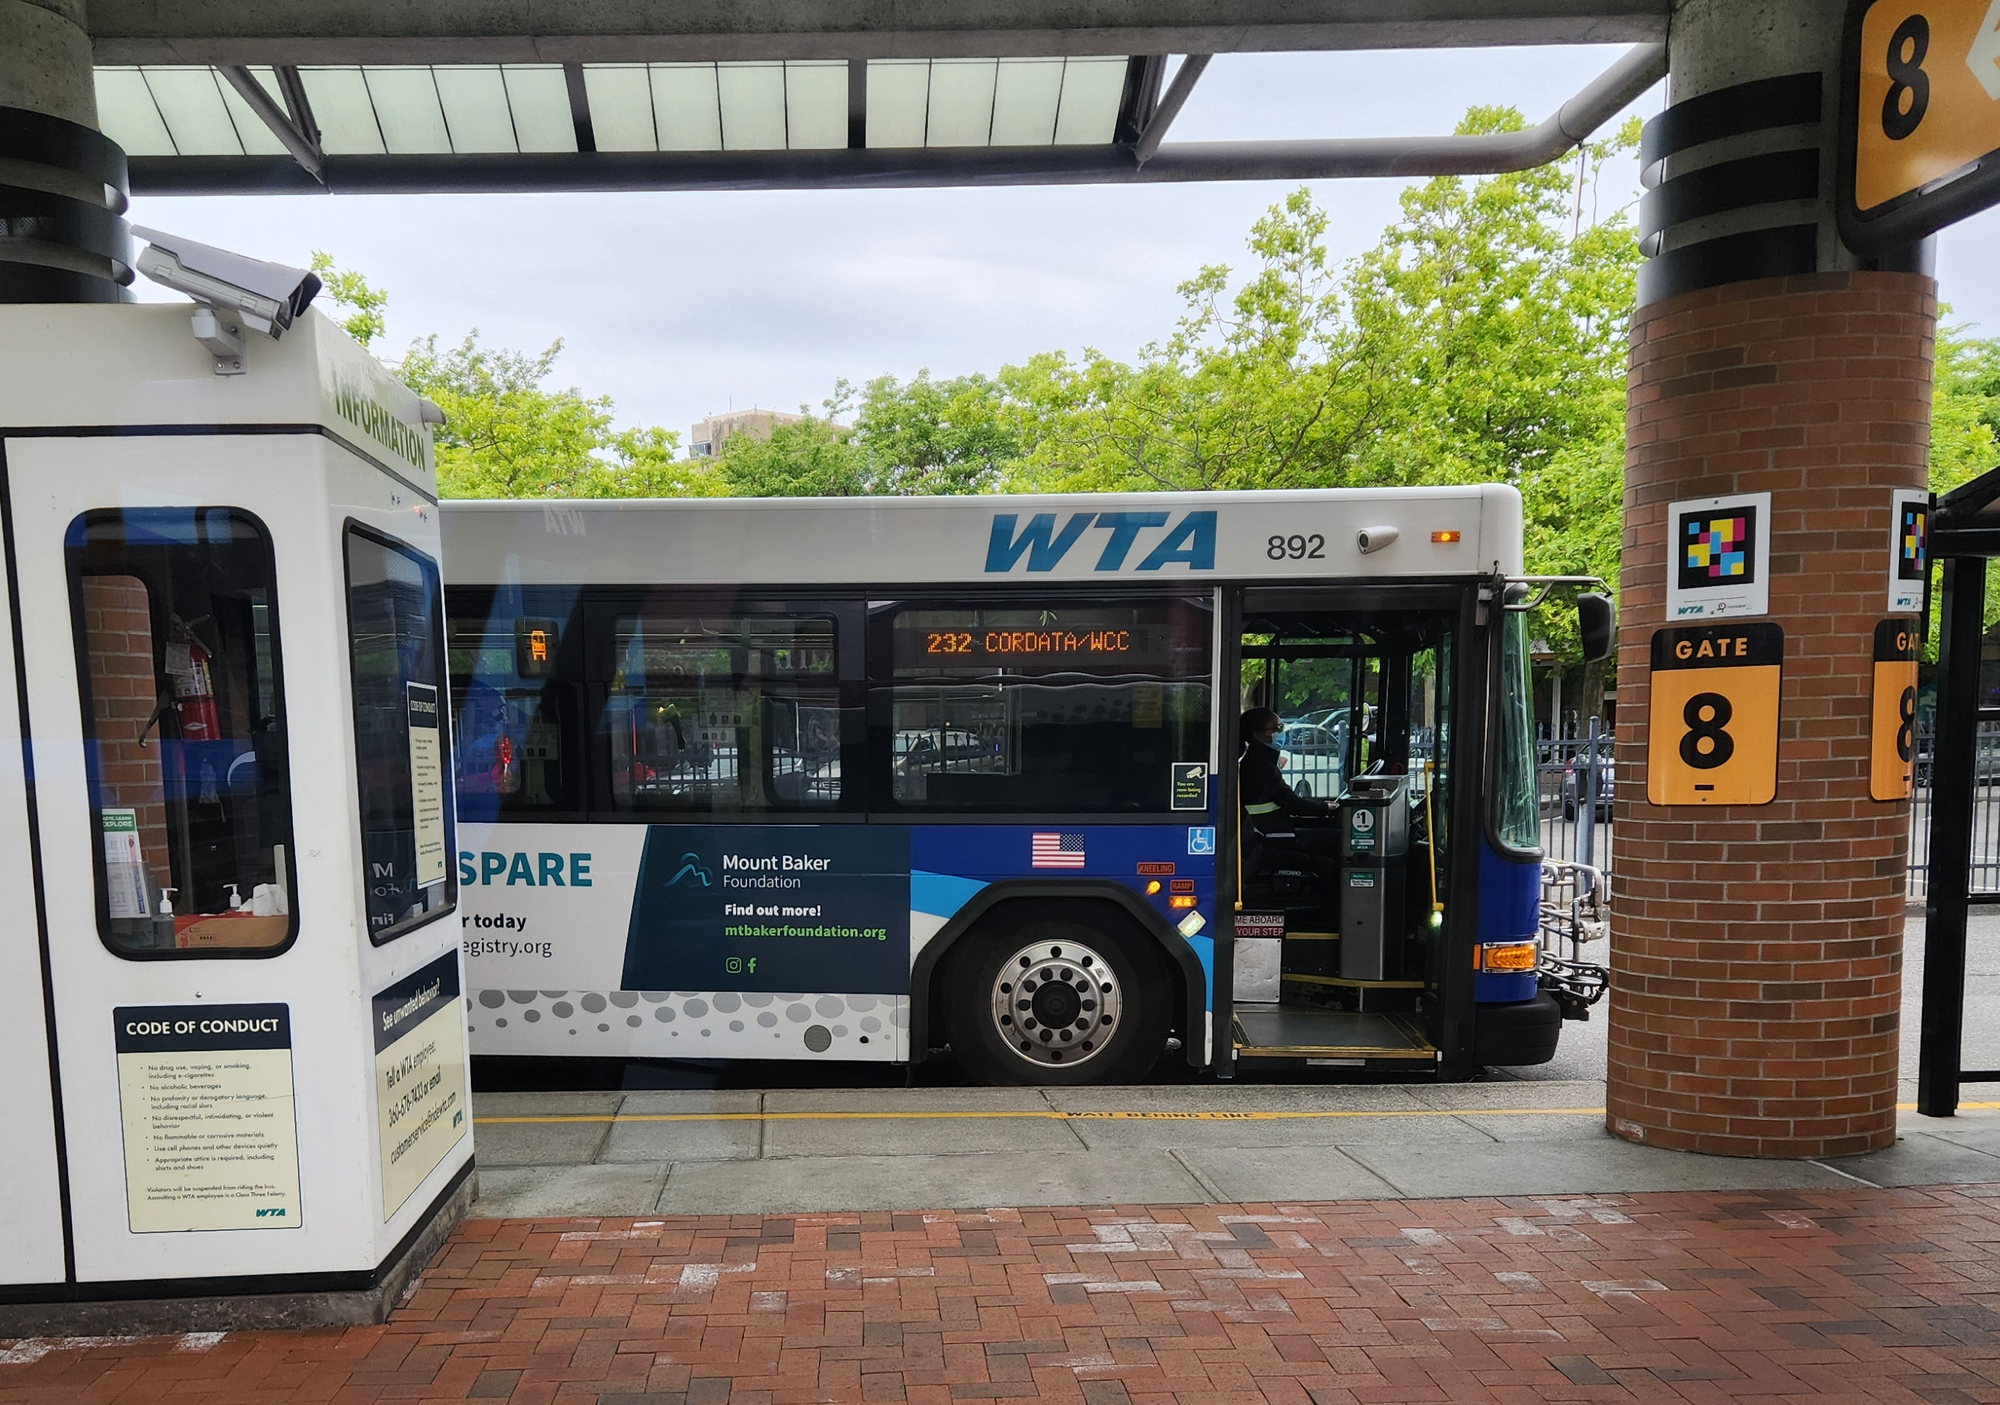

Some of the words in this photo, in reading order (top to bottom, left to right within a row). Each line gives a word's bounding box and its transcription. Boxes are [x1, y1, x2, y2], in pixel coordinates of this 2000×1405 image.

[1881, 13, 1930, 141] 8
[335, 388, 426, 473] INFORMATION
[983, 510, 1218, 573] WTA
[1266, 533, 1326, 560] 892
[1677, 605, 1704, 615] WTA
[1896, 597, 1911, 606] WTA
[927, 632, 972, 653] 232
[985, 630, 1130, 652] CORDATA/WCC
[1675, 637, 1748, 660] GATE
[1678, 691, 1735, 770] 8
[1896, 685, 1915, 764] 8
[458, 850, 593, 887] SPARE
[722, 854, 778, 871] Mount
[782, 854, 831, 871] Baker
[1140, 864, 1172, 872] KNEELING
[723, 874, 801, 888] Foundation
[1172, 882, 1192, 890] RAMP
[724, 904, 753, 916] Find
[756, 905, 779, 916] out
[782, 905, 822, 917] more!
[1249, 916, 1284, 924] ABOARD
[474, 913, 527, 932] today
[1236, 928, 1260, 936] YOUR
[1262, 928, 1284, 936] STEP
[724, 924, 887, 941] mtbakerfoundation.org
[382, 1011, 393, 1031] See
[394, 989, 418, 1024] unwanted
[418, 977, 440, 1008] behavior?
[126, 1022, 171, 1035] CODE
[174, 1021, 196, 1034] OF
[200, 1019, 279, 1034] CONDUCT
[159, 1064, 174, 1072] drug
[178, 1072, 214, 1080] e-cigarettes
[386, 1065, 395, 1090] Tell
[396, 1069, 400, 1083] a
[400, 1054, 413, 1078] WTA
[388, 1081, 424, 1128] 360-676-7433
[424, 1083, 429, 1096] or
[429, 1064, 441, 1090] email
[390, 1091, 456, 1165] customerservice@ridewta.com
[453, 1108, 463, 1129] WTA
[256, 1208, 286, 1217] WTA
